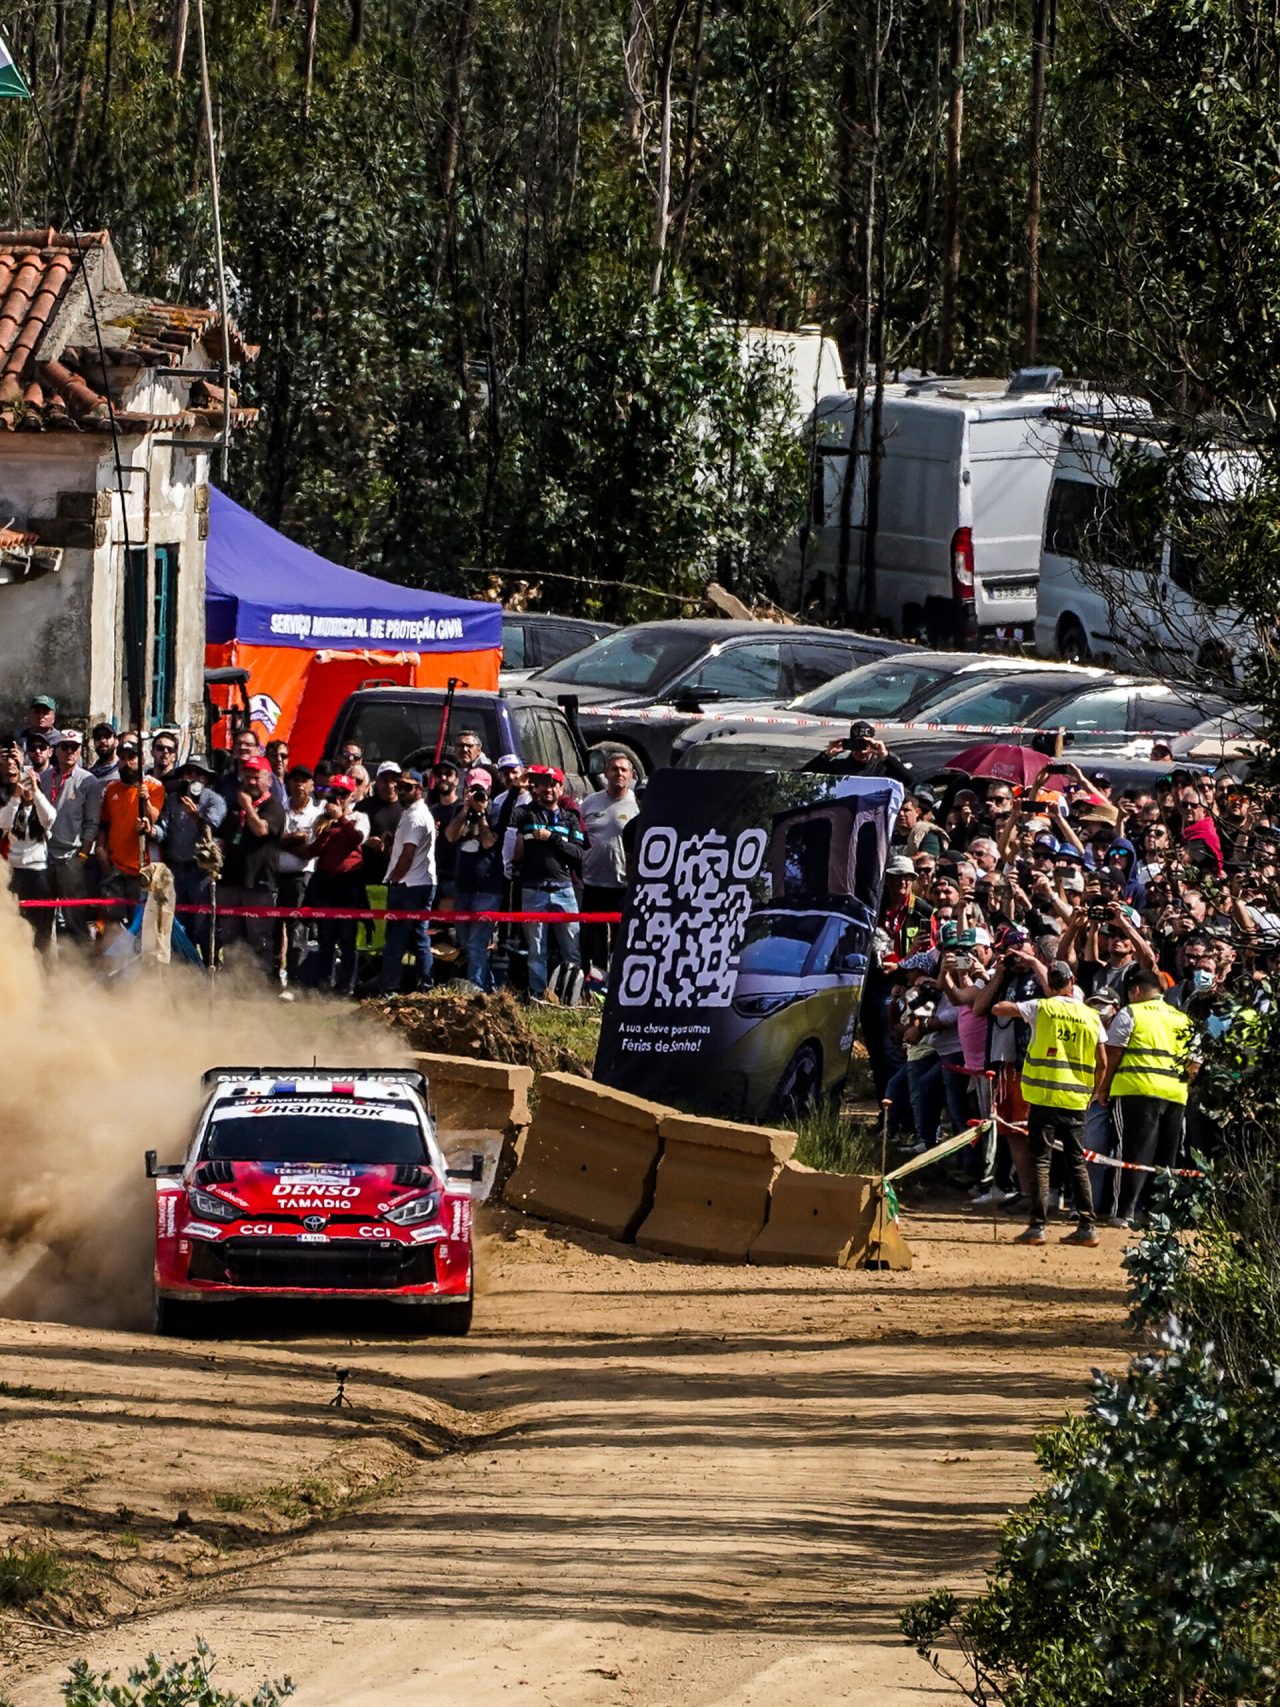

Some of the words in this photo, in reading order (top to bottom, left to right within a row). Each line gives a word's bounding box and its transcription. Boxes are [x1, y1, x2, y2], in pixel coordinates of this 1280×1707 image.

[270, 614, 311, 641] SERVIÇO
[311, 615, 369, 638] MUNICIPAL
[370, 618, 386, 639] DE
[386, 616, 436, 644] PROTEÇÃO
[436, 617, 464, 639] CIVIL
[626, 1024, 641, 1033] sua
[643, 1022, 669, 1034] chave
[1056, 1028, 1077, 1043] 251
[621, 1038, 652, 1052] Férias
[654, 1039, 670, 1053] de
[271, 1184, 362, 1198] DENSO
[239, 1224, 273, 1235] CCI
[358, 1226, 391, 1238] CCI
